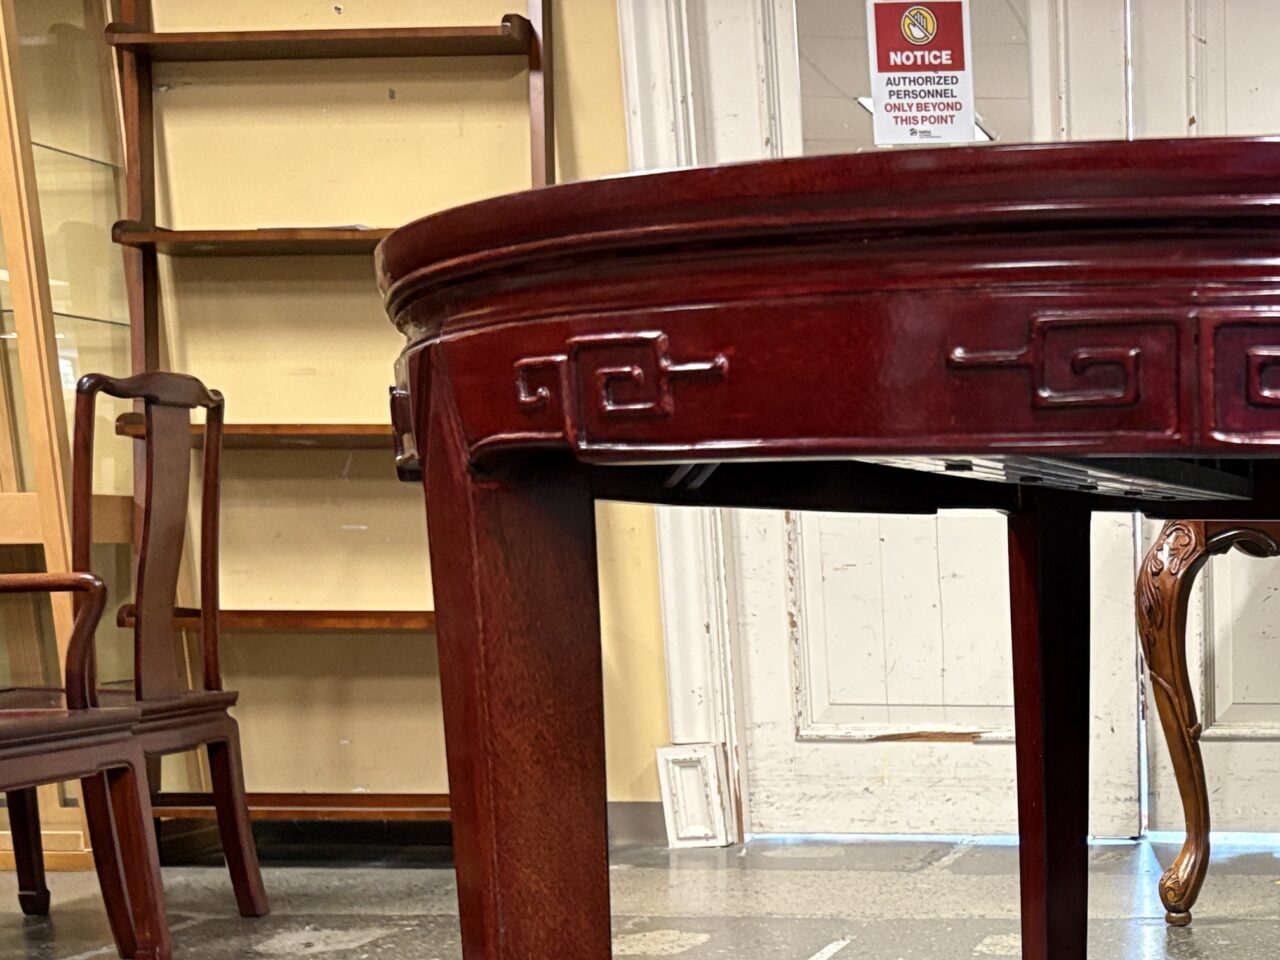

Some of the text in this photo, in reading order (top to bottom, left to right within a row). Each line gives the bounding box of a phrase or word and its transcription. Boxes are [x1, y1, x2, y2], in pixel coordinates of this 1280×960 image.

[889, 50, 952, 65] NOTICE
[885, 75, 959, 87] AUTHORIZED
[888, 89, 957, 99] PERSONNEL
[884, 101, 962, 113] ONLY BEYOND
[893, 114, 955, 125] THIS POINT
